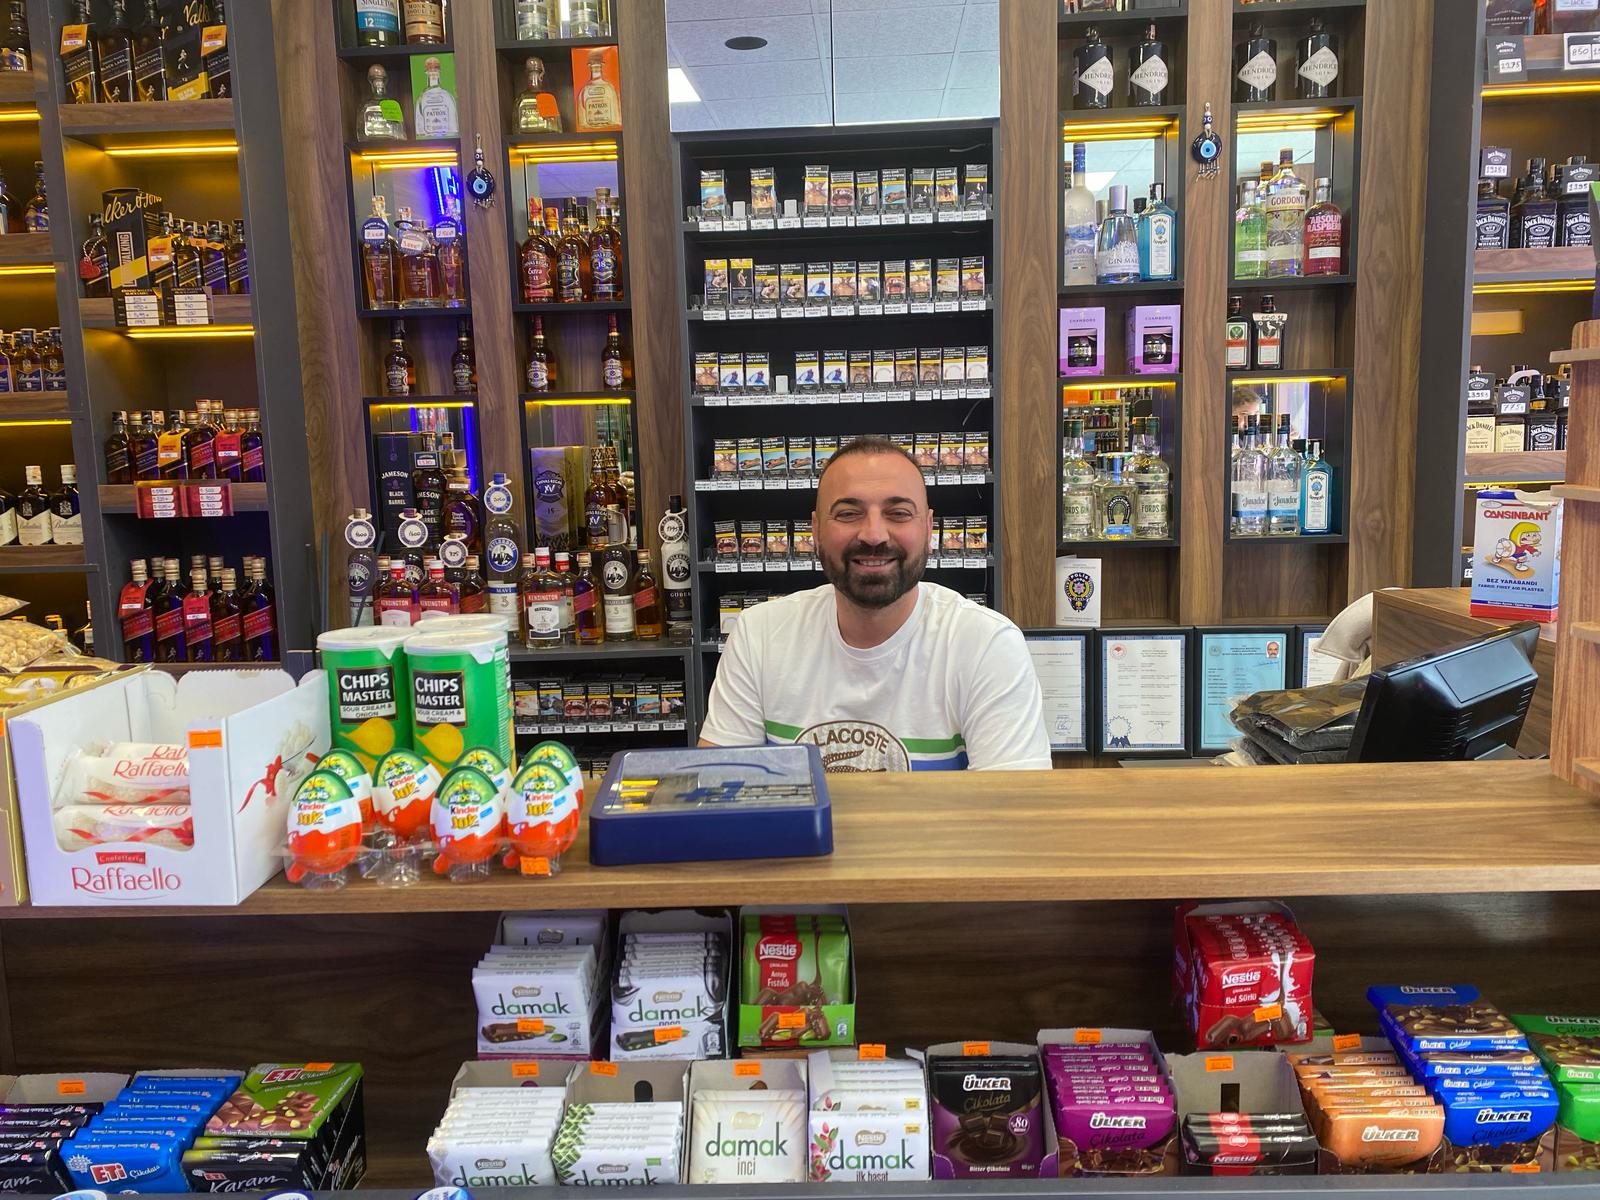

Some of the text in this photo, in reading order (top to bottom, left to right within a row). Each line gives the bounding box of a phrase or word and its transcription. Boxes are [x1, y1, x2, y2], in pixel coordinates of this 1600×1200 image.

[365, 18, 374, 28] 12
[381, 470, 409, 479] JAMESON
[1484, 509, 1550, 521] CANSINBANT
[340, 672, 390, 690] CHIPS
[415, 677, 459, 692] CHIPS
[342, 689, 391, 702] MASTER
[416, 694, 461, 706] MASTER
[813, 728, 889, 755] LACOSTE
[71, 867, 182, 892] Raffaello
[771, 970, 787, 979] Antep
[491, 992, 570, 1016] damak
[1225, 993, 1257, 1005] Bol Sütlü
[628, 996, 709, 1023] damak
[963, 1074, 1011, 1091] ÜLKER
[1089, 1113, 1146, 1129] ÜLKER
[1475, 1108, 1532, 1123] ÜLKER
[705, 1121, 788, 1157] damak
[1361, 1126, 1419, 1142] ÜLKER
[829, 1139, 914, 1170] damak
[452, 1163, 539, 1187] damak
[736, 1158, 756, 1176] inci
